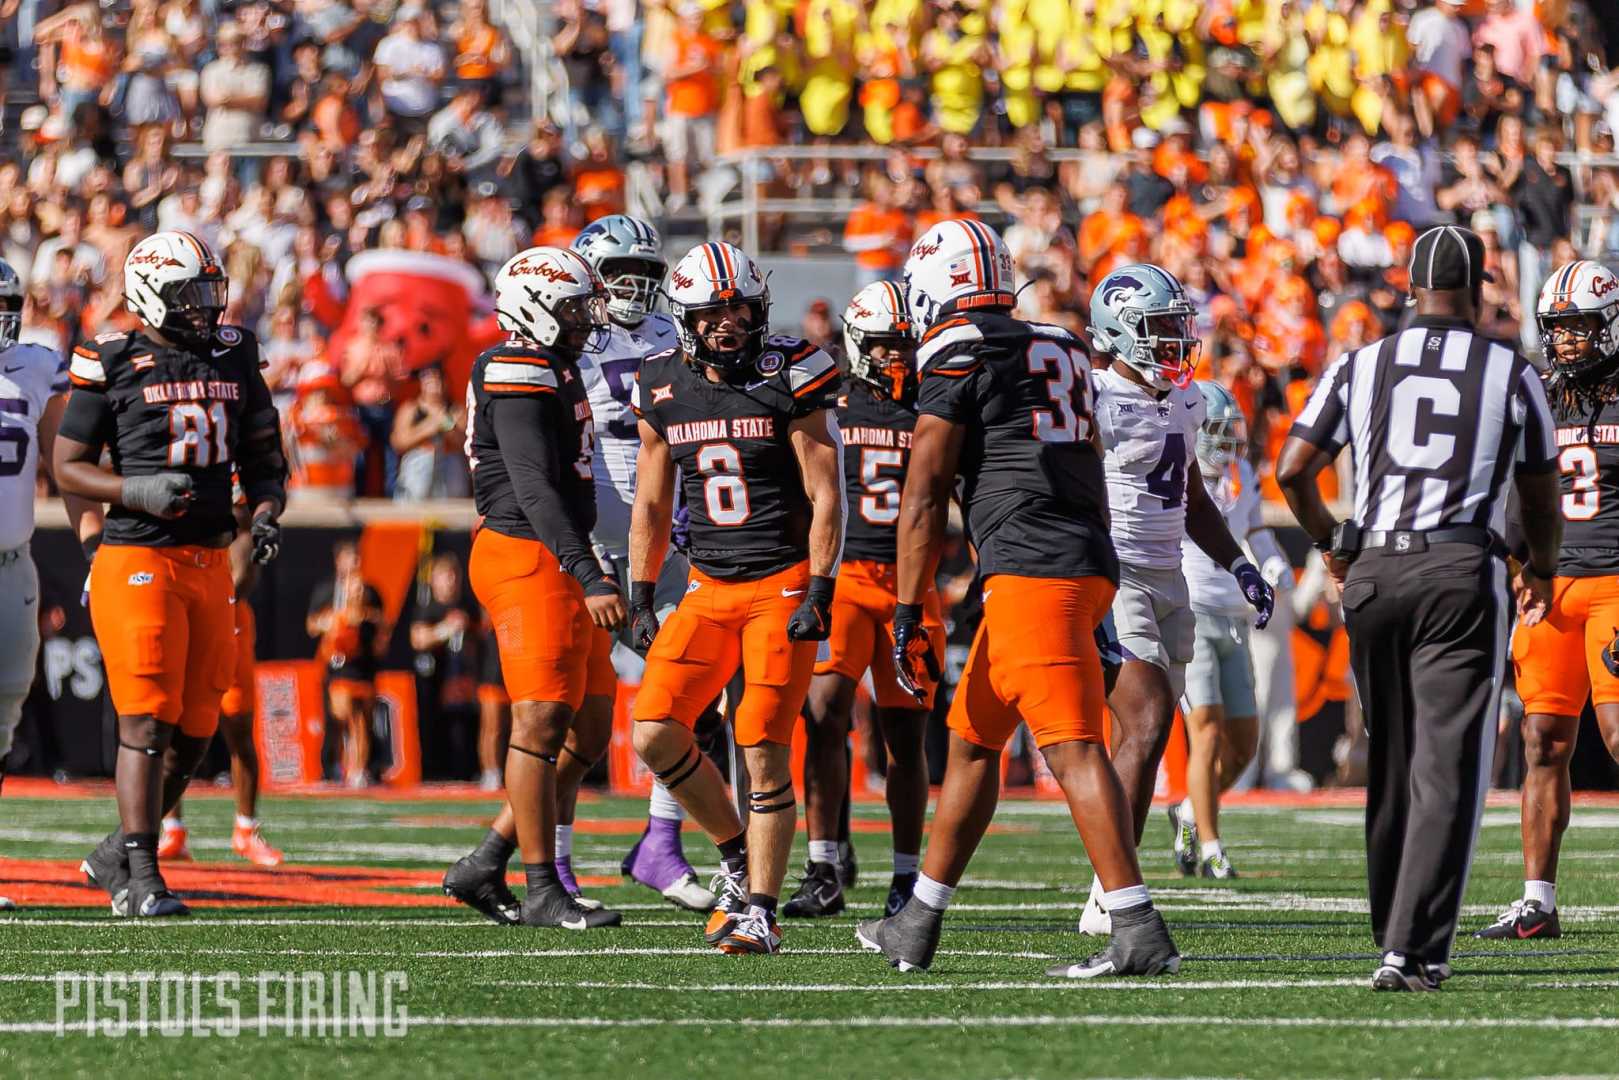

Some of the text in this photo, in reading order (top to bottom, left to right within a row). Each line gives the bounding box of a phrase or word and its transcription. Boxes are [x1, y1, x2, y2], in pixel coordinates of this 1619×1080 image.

[508, 257, 579, 283] Cowboys
[143, 381, 240, 403] OKLAHOMA STATE
[1386, 374, 1461, 470] C
[667, 416, 775, 446] OKLAHOMA STATE
[696, 442, 752, 527] 8
[859, 447, 903, 526] 5
[1145, 432, 1187, 510] 4
[1557, 446, 1600, 522] 3
